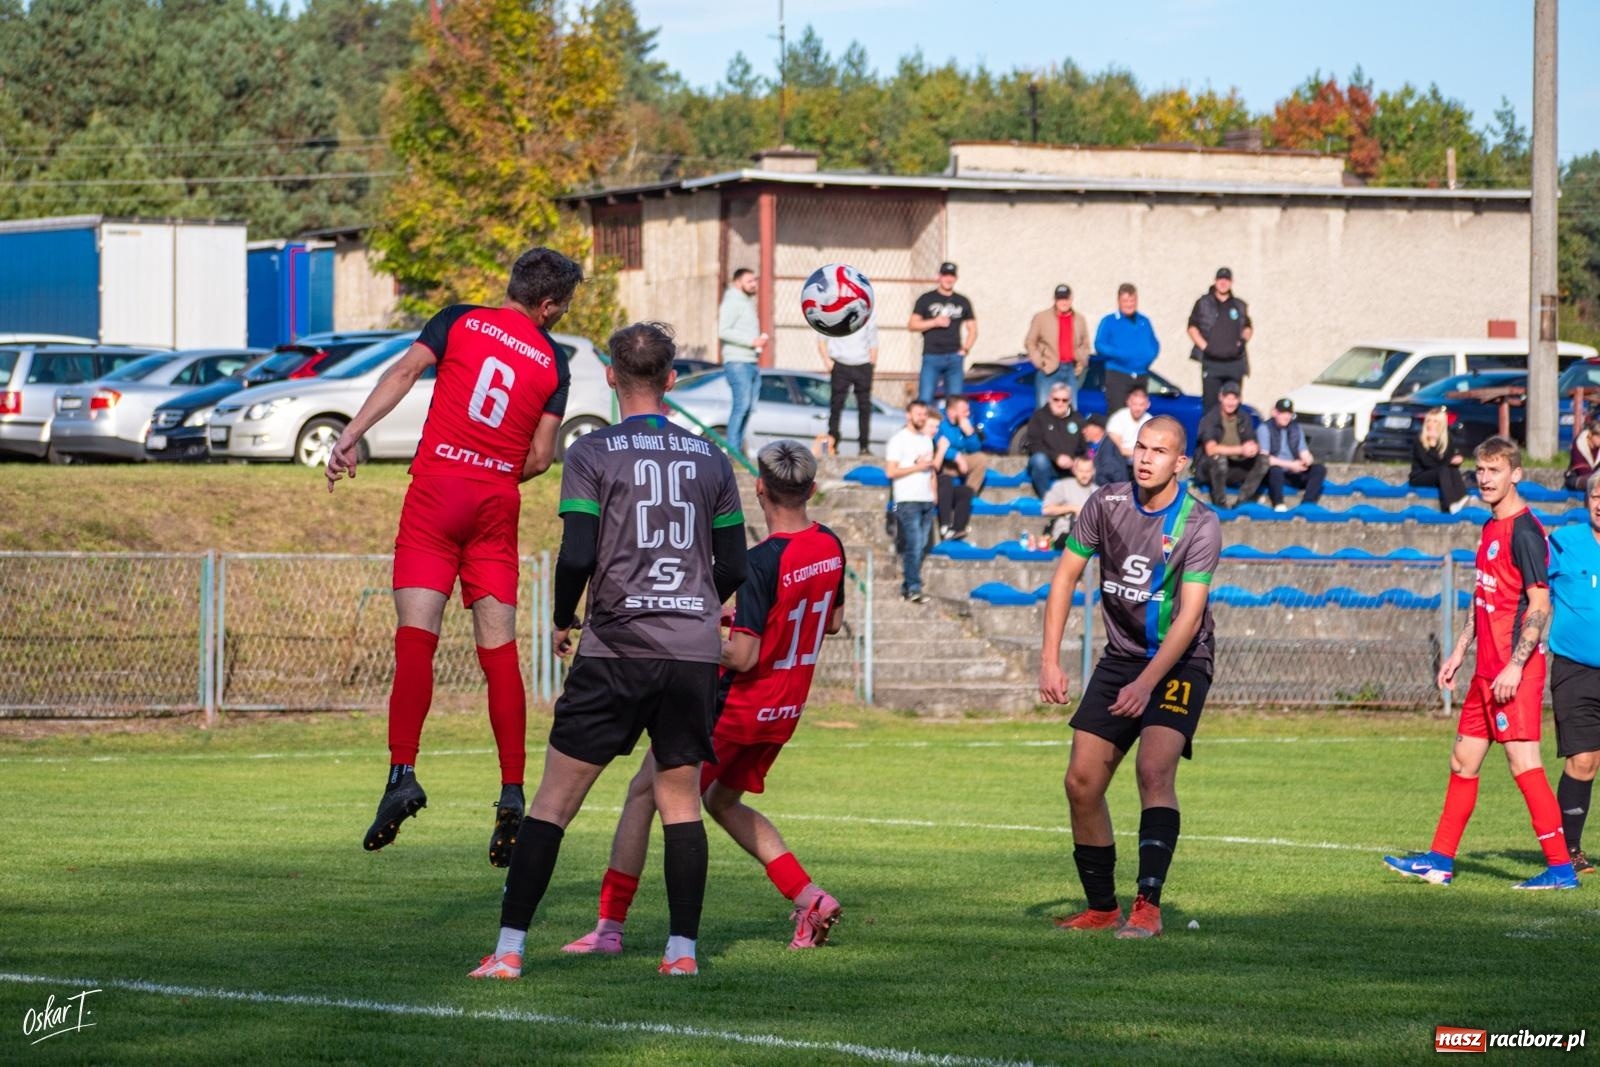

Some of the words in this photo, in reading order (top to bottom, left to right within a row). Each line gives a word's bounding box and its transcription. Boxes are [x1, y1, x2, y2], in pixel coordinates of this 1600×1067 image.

[465, 318, 480, 332] KS
[481, 322, 552, 369] GOTARTOWICE
[468, 356, 516, 429] 6
[435, 443, 514, 472] CUTLINE
[606, 434, 629, 452] LKS
[632, 432, 665, 451] GÓRKI
[669, 433, 712, 457] ŚLĄSKIE
[634, 458, 697, 550] 25
[625, 595, 704, 611] STAGE
[1103, 580, 1165, 602] STAGE
[773, 590, 833, 670] 11
[1165, 679, 1191, 705] 21
[757, 703, 805, 721] CUTL
